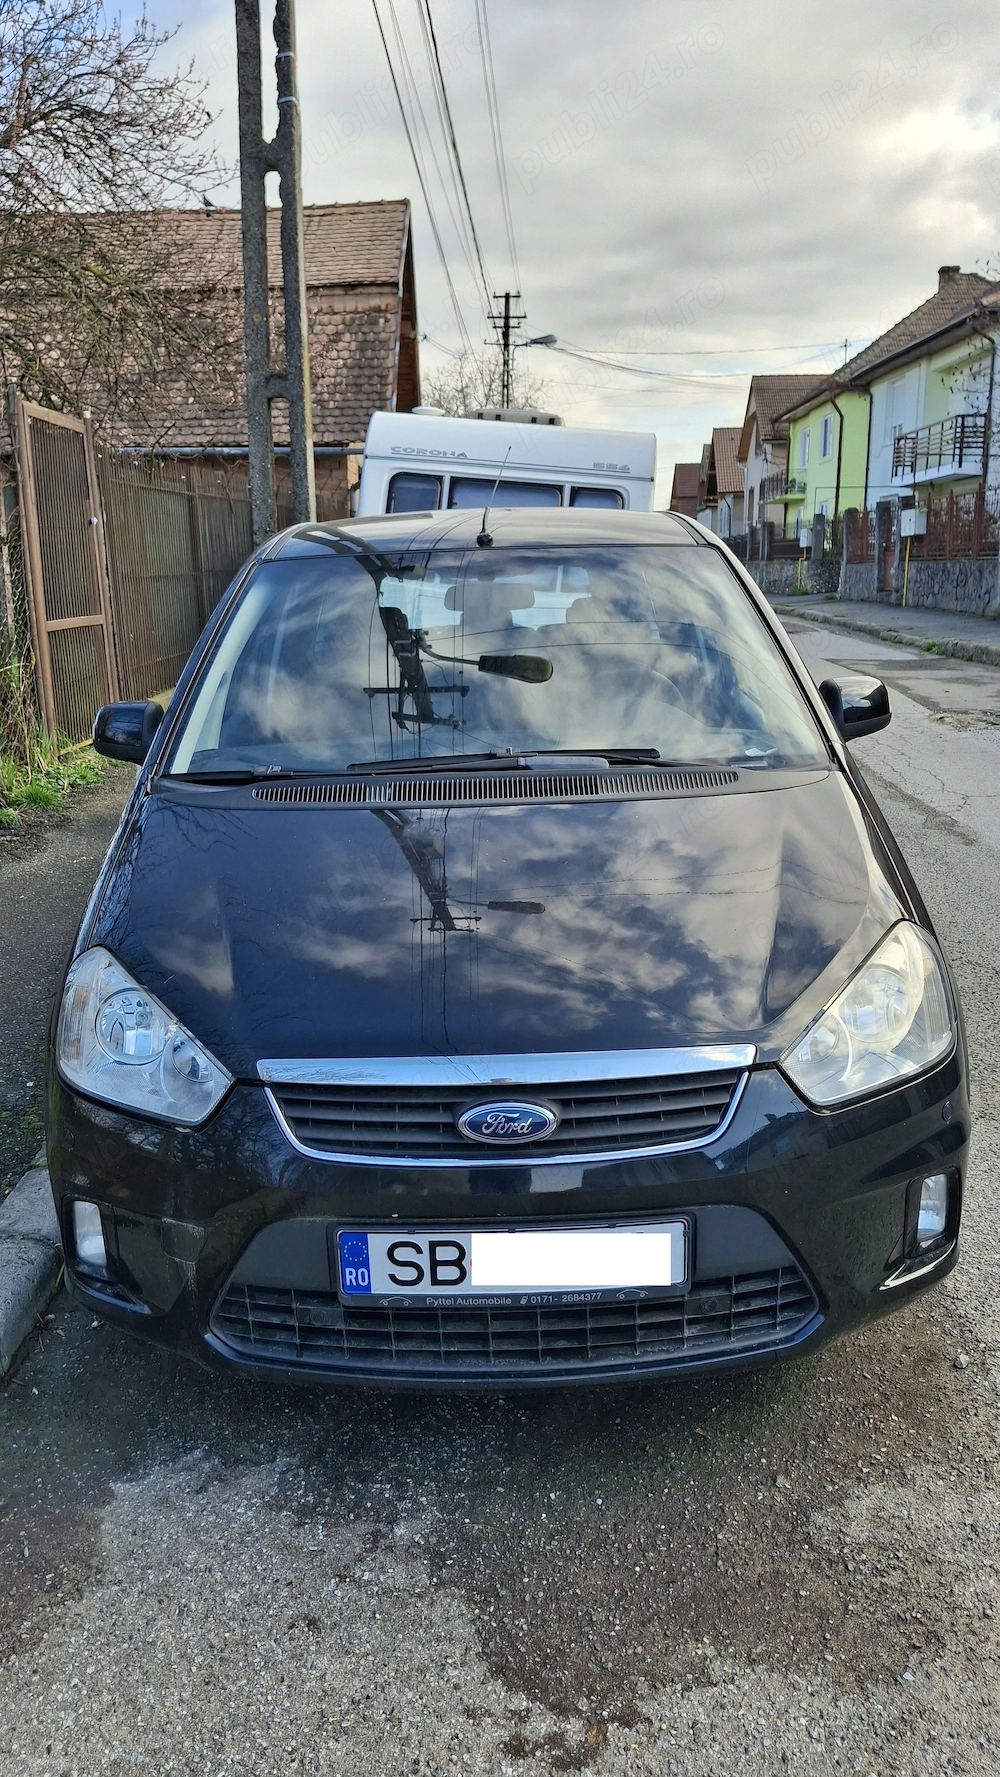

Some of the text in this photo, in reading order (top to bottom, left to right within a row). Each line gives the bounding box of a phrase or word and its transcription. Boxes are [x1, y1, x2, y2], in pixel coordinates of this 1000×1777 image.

[481, 1112, 533, 1135] Ford
[386, 1239, 468, 1287] SB
[345, 1267, 369, 1287] RO
[426, 1297, 454, 1307] Pyttel
[456, 1296, 512, 1306] Automobile
[561, 1291, 603, 1303] 2684377
